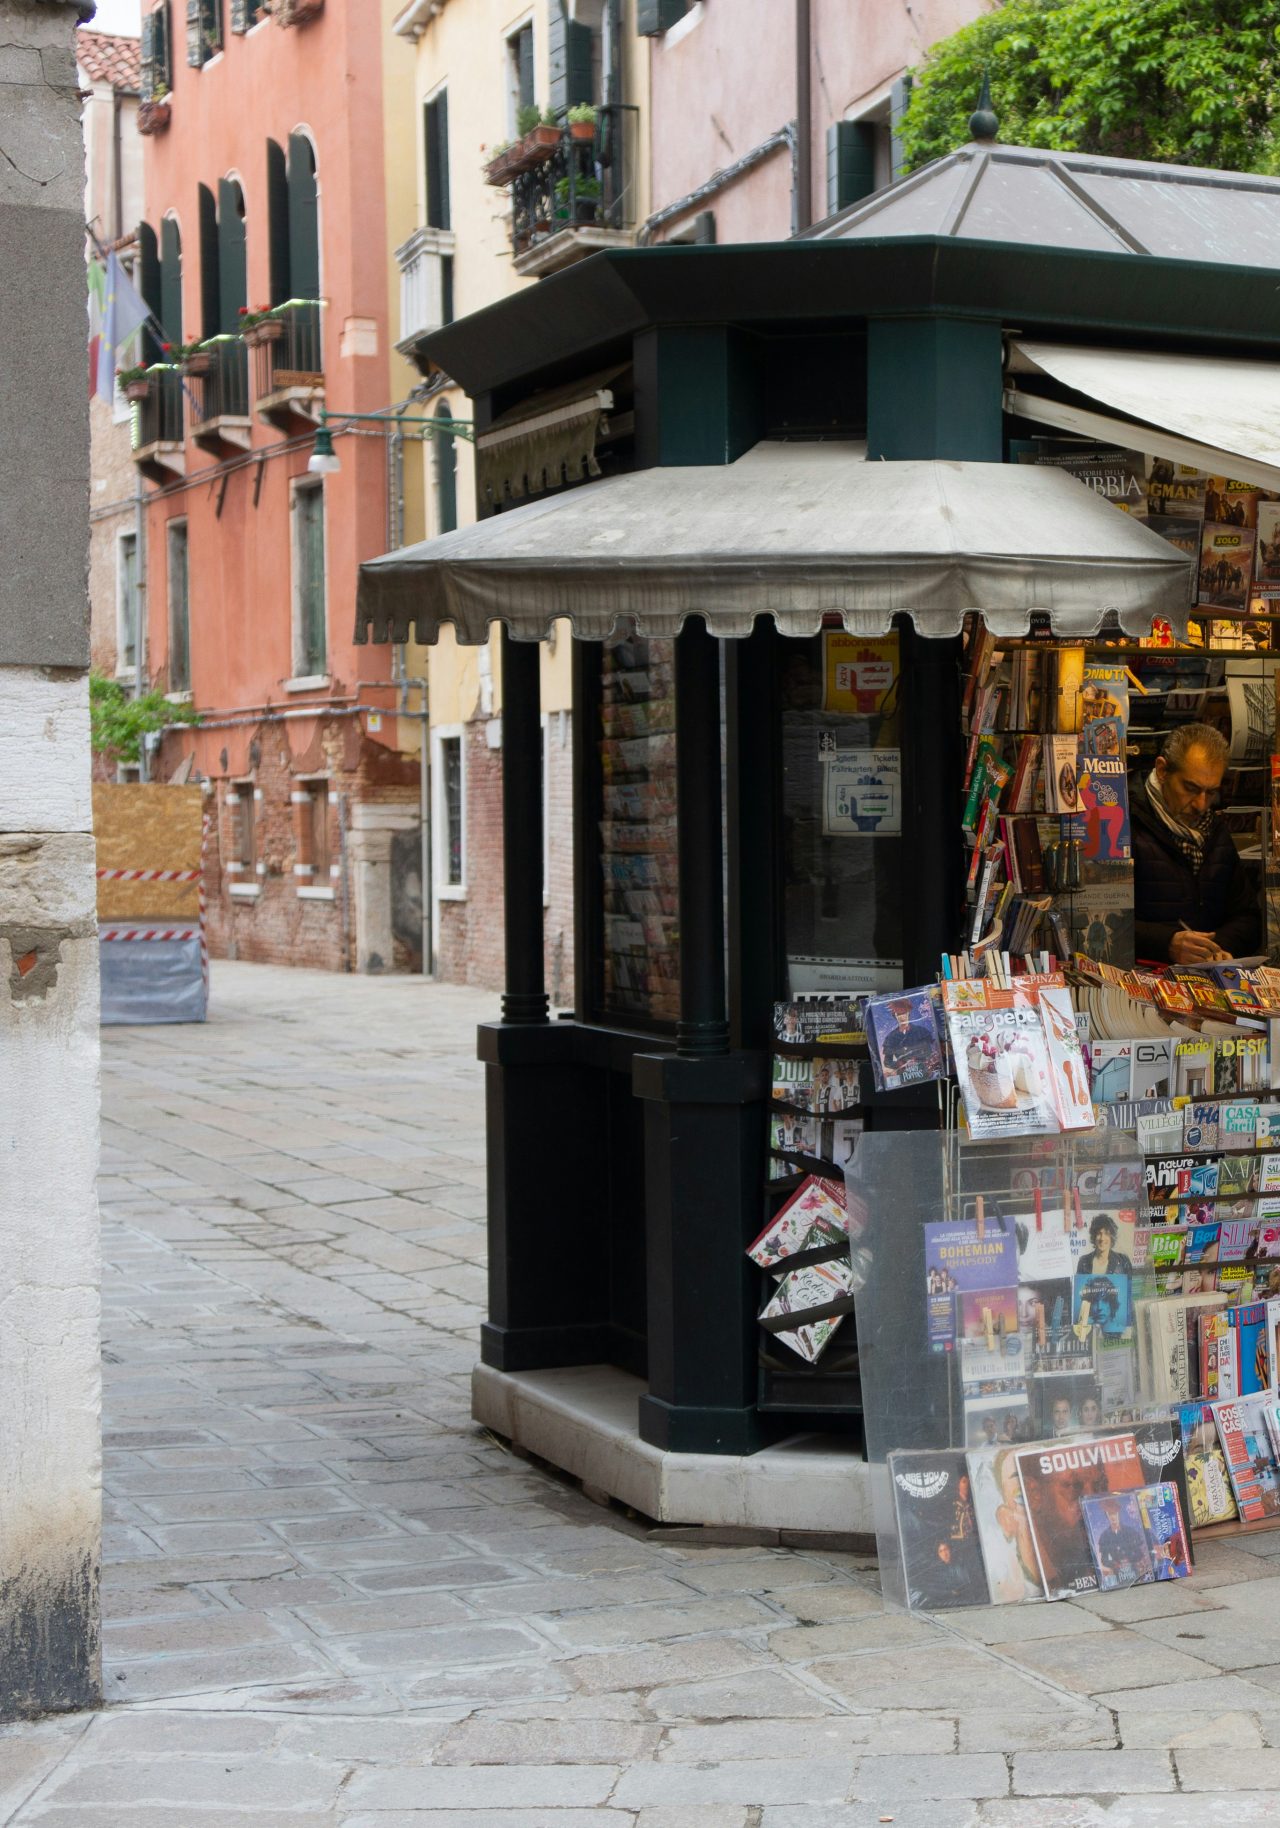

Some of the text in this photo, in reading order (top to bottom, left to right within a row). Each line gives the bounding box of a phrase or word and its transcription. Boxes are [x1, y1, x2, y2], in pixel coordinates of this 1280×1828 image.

[1215, 536, 1239, 546] SOLO
[1225, 1106, 1261, 1119] CASA
[1159, 1158, 1193, 1170] nature
[940, 1242, 1004, 1259] BOHEMIAN
[1039, 1441, 1136, 1475] SOULVILLE
